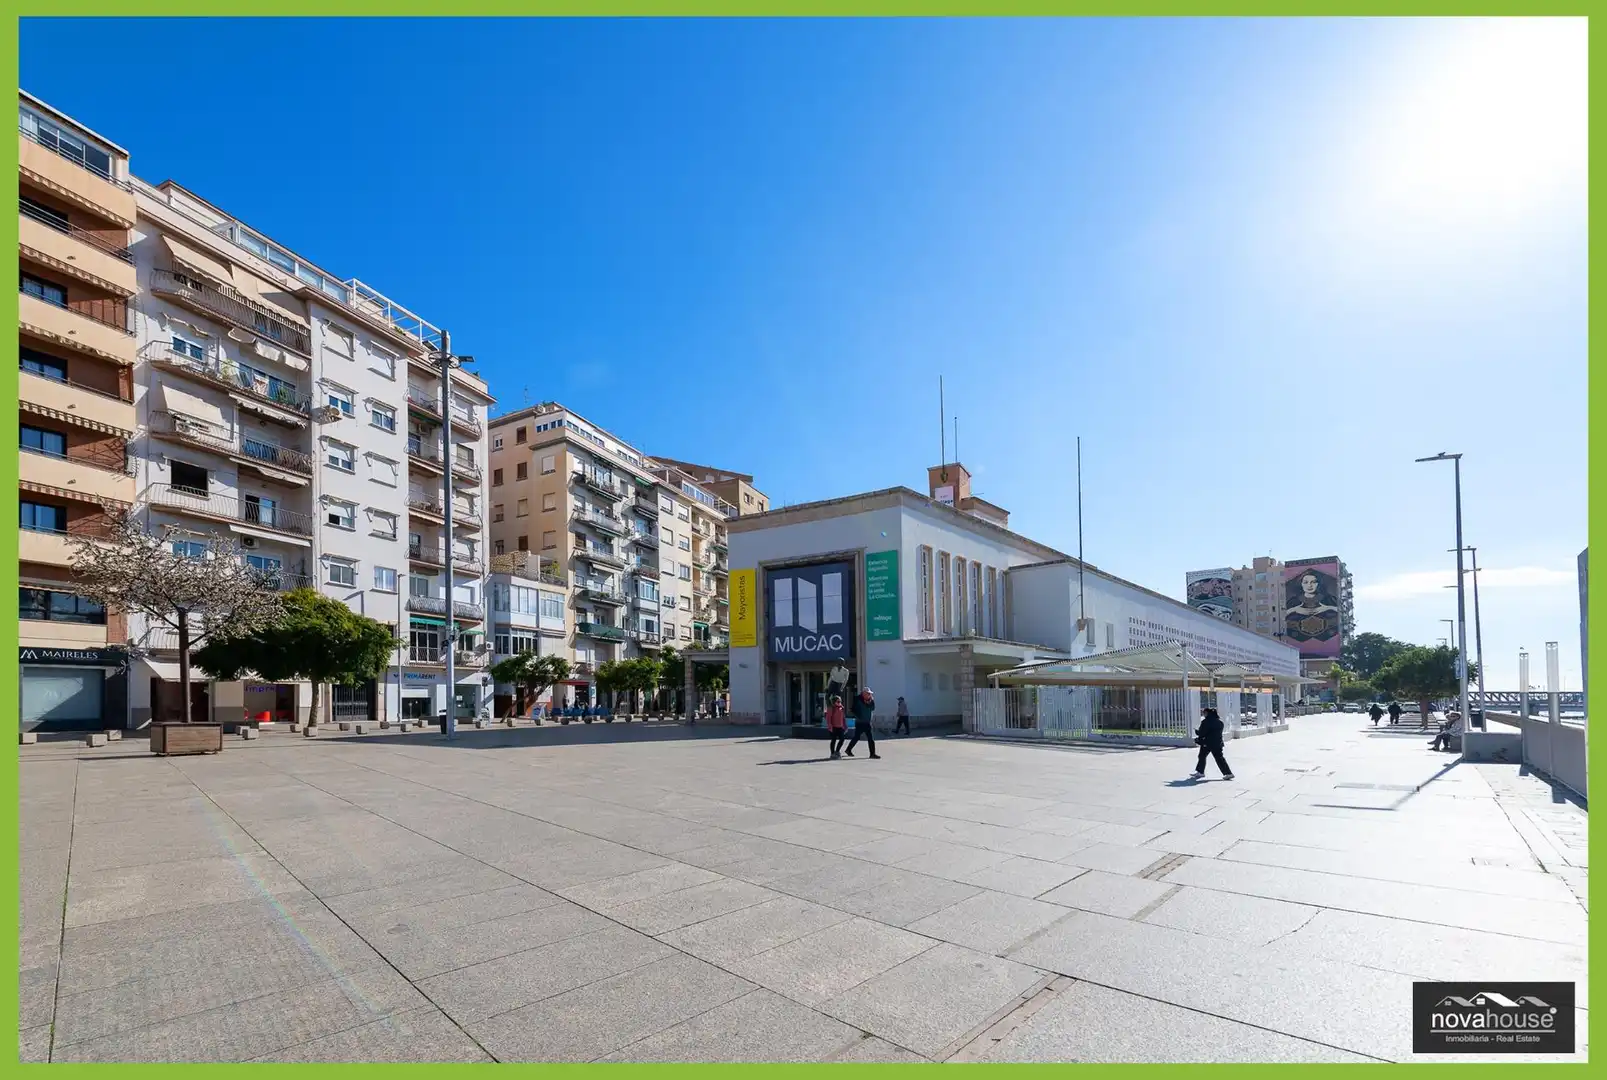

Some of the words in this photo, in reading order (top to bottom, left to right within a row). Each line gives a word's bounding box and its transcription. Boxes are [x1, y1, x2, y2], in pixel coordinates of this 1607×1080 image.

[738, 575, 748, 620] Mayoristas
[775, 634, 843, 652] MUCAC
[42, 650, 98, 659] MAIRELES
[403, 672, 436, 680] PRIMARENT
